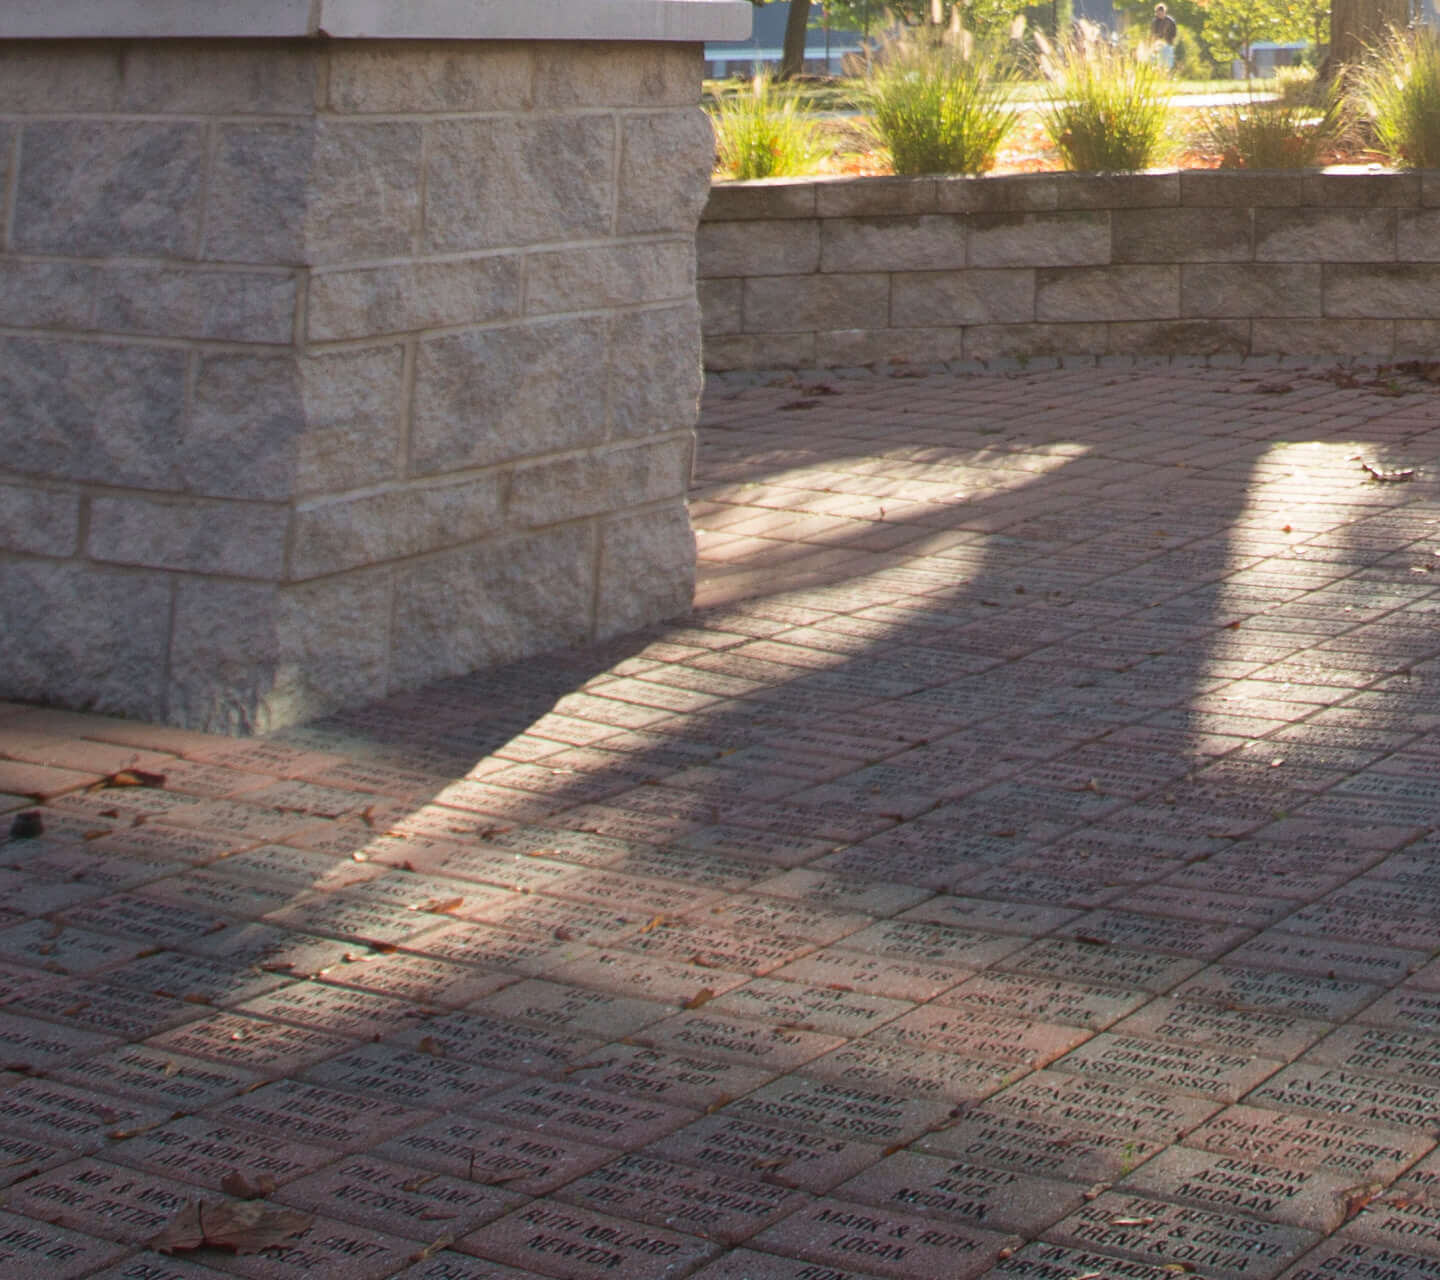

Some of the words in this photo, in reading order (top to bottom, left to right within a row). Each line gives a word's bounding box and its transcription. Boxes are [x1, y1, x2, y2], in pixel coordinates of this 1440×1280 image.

[1213, 1157, 1313, 1184] DUNCAN
[1190, 1169, 1304, 1198] ACHESON
[1125, 1198, 1169, 1217] THE
[812, 1208, 888, 1234] MARK
[888, 1224, 911, 1239] &
[1167, 1225, 1191, 1238] &
[1039, 1246, 1073, 1262] IN
[1071, 1223, 1150, 1249] TRENT
[1147, 1240, 1168, 1254] &
[1171, 1245, 1251, 1272] OLIVIA
[1337, 1241, 1372, 1257] IN
